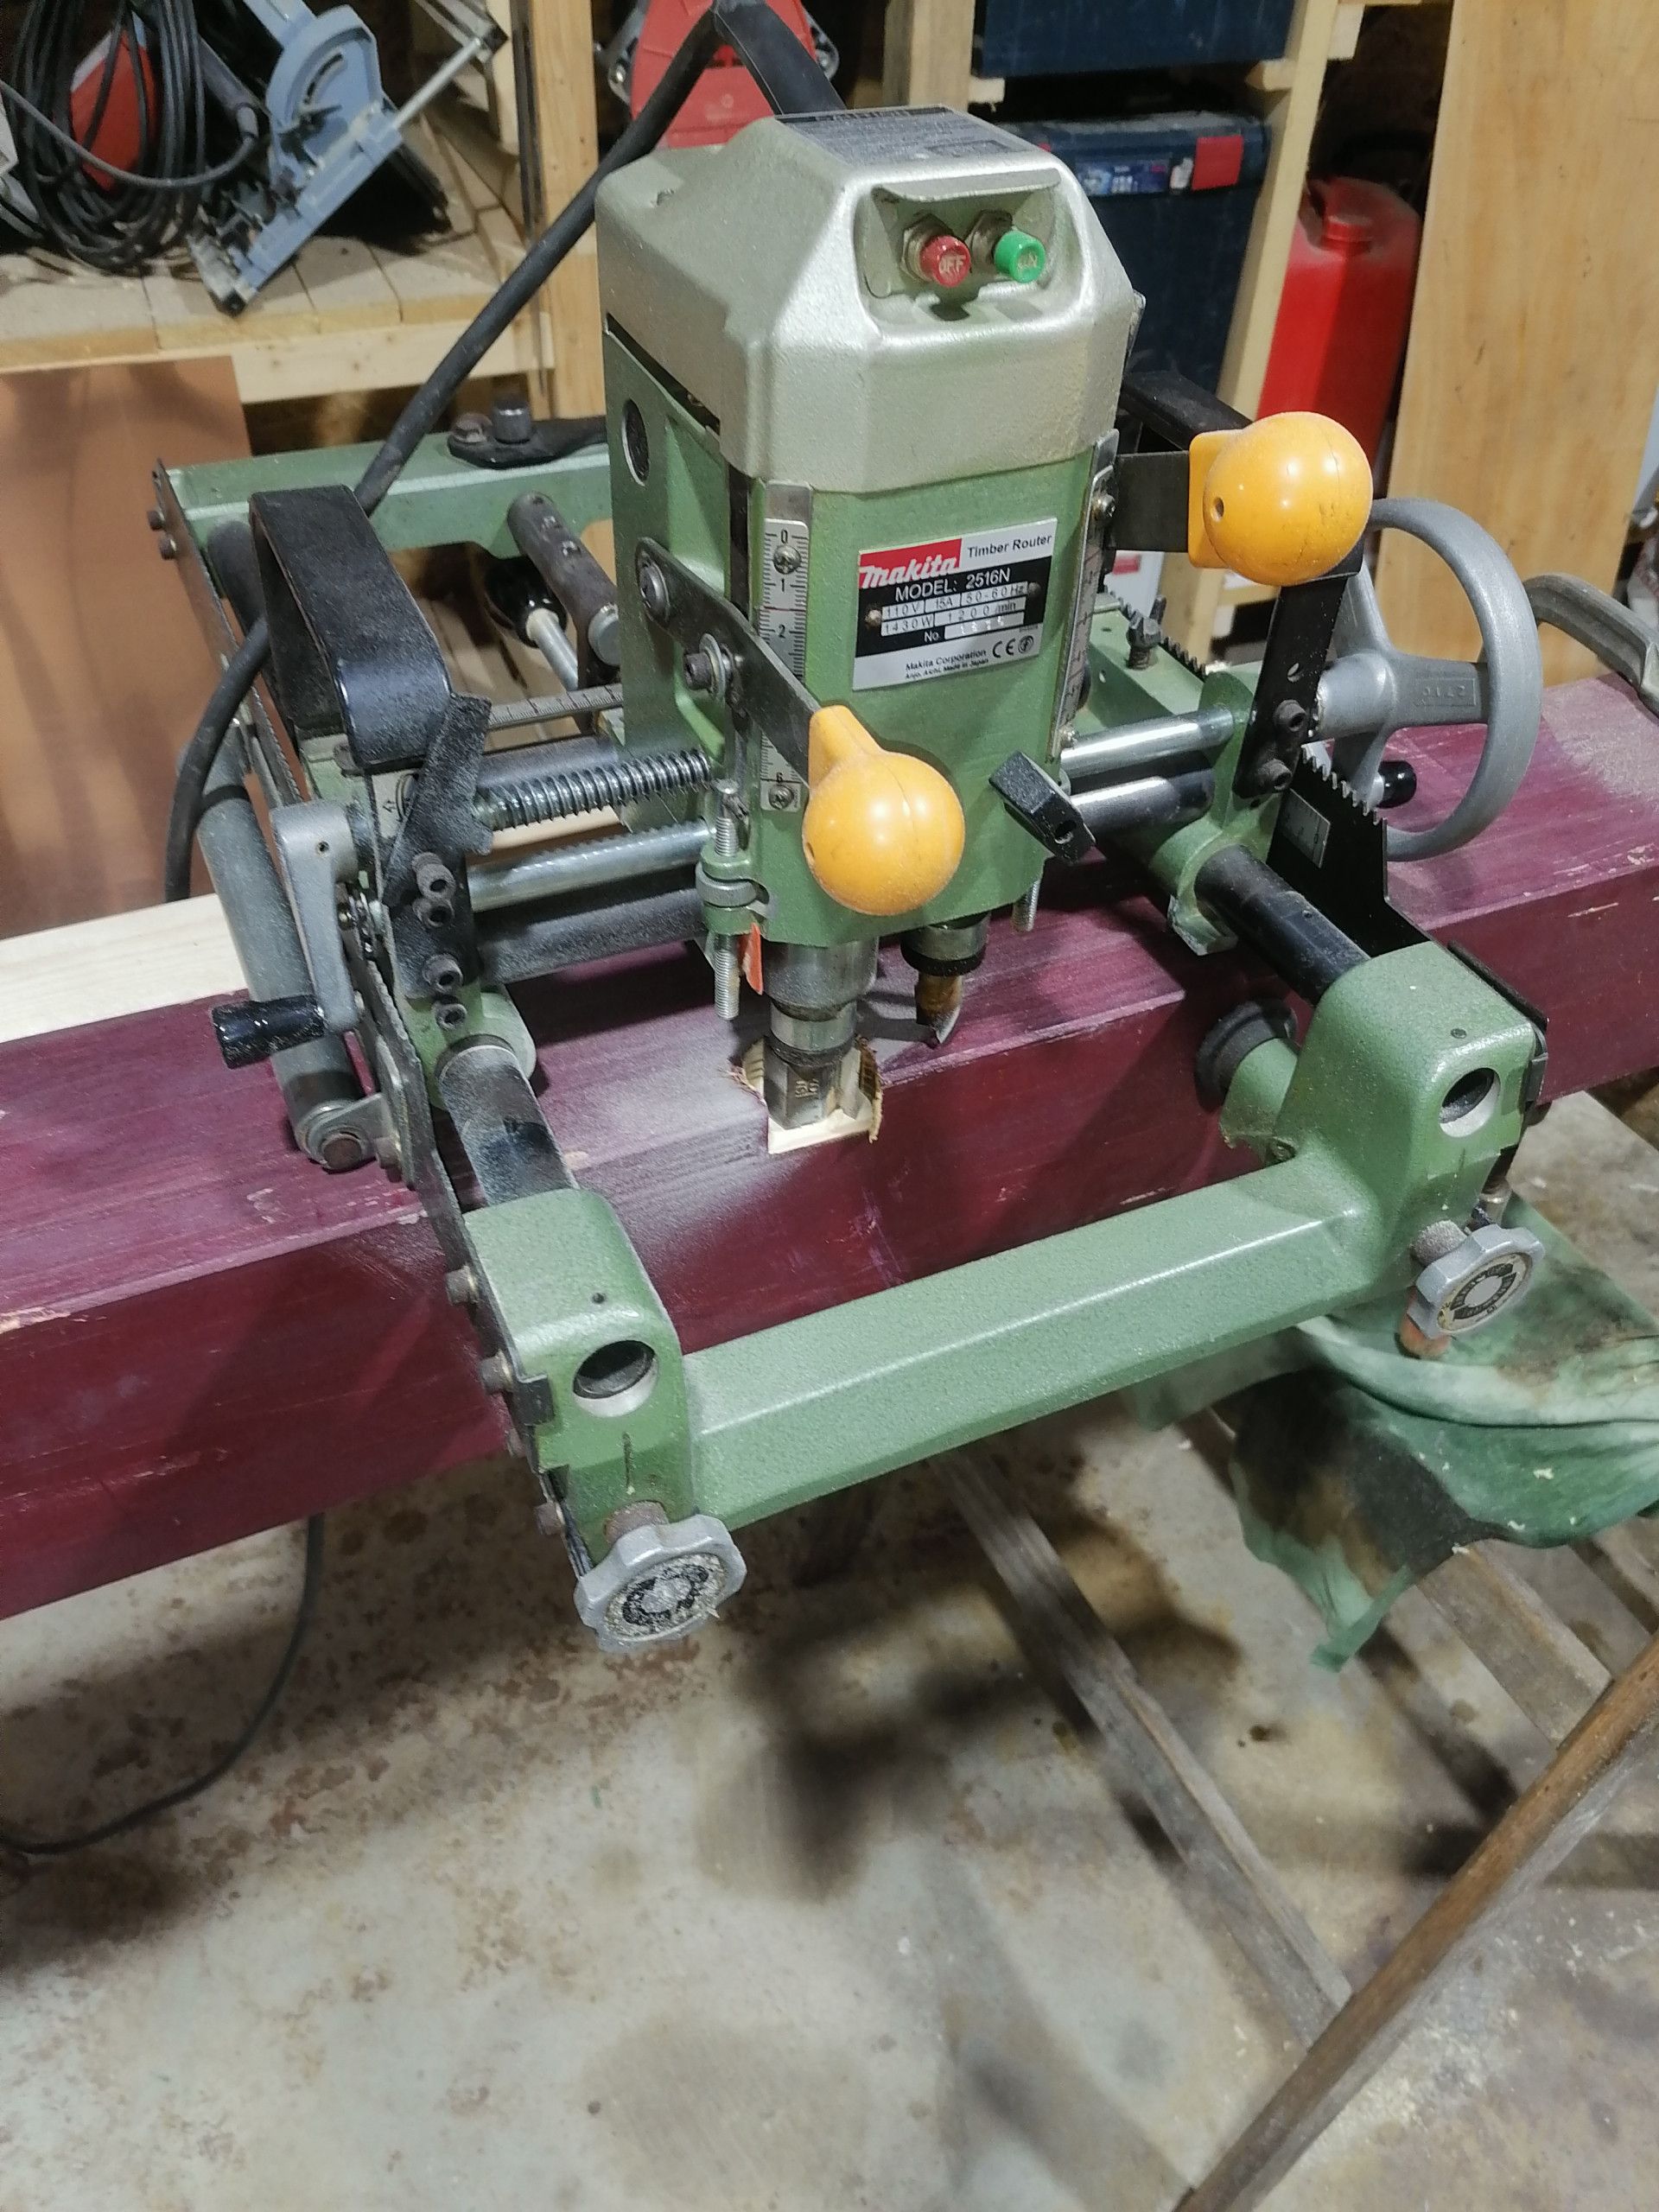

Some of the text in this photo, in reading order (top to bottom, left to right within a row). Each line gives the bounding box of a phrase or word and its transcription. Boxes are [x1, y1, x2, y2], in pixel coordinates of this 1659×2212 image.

[780, 530, 788, 543] 0
[968, 534, 1052, 558] Timber Router
[780, 578, 785, 592] 1
[895, 567, 1011, 602] MODEL: 2516N
[936, 596, 953, 611] 15A
[779, 624, 785, 639] 2
[906, 649, 987, 671] Makita Corporation
